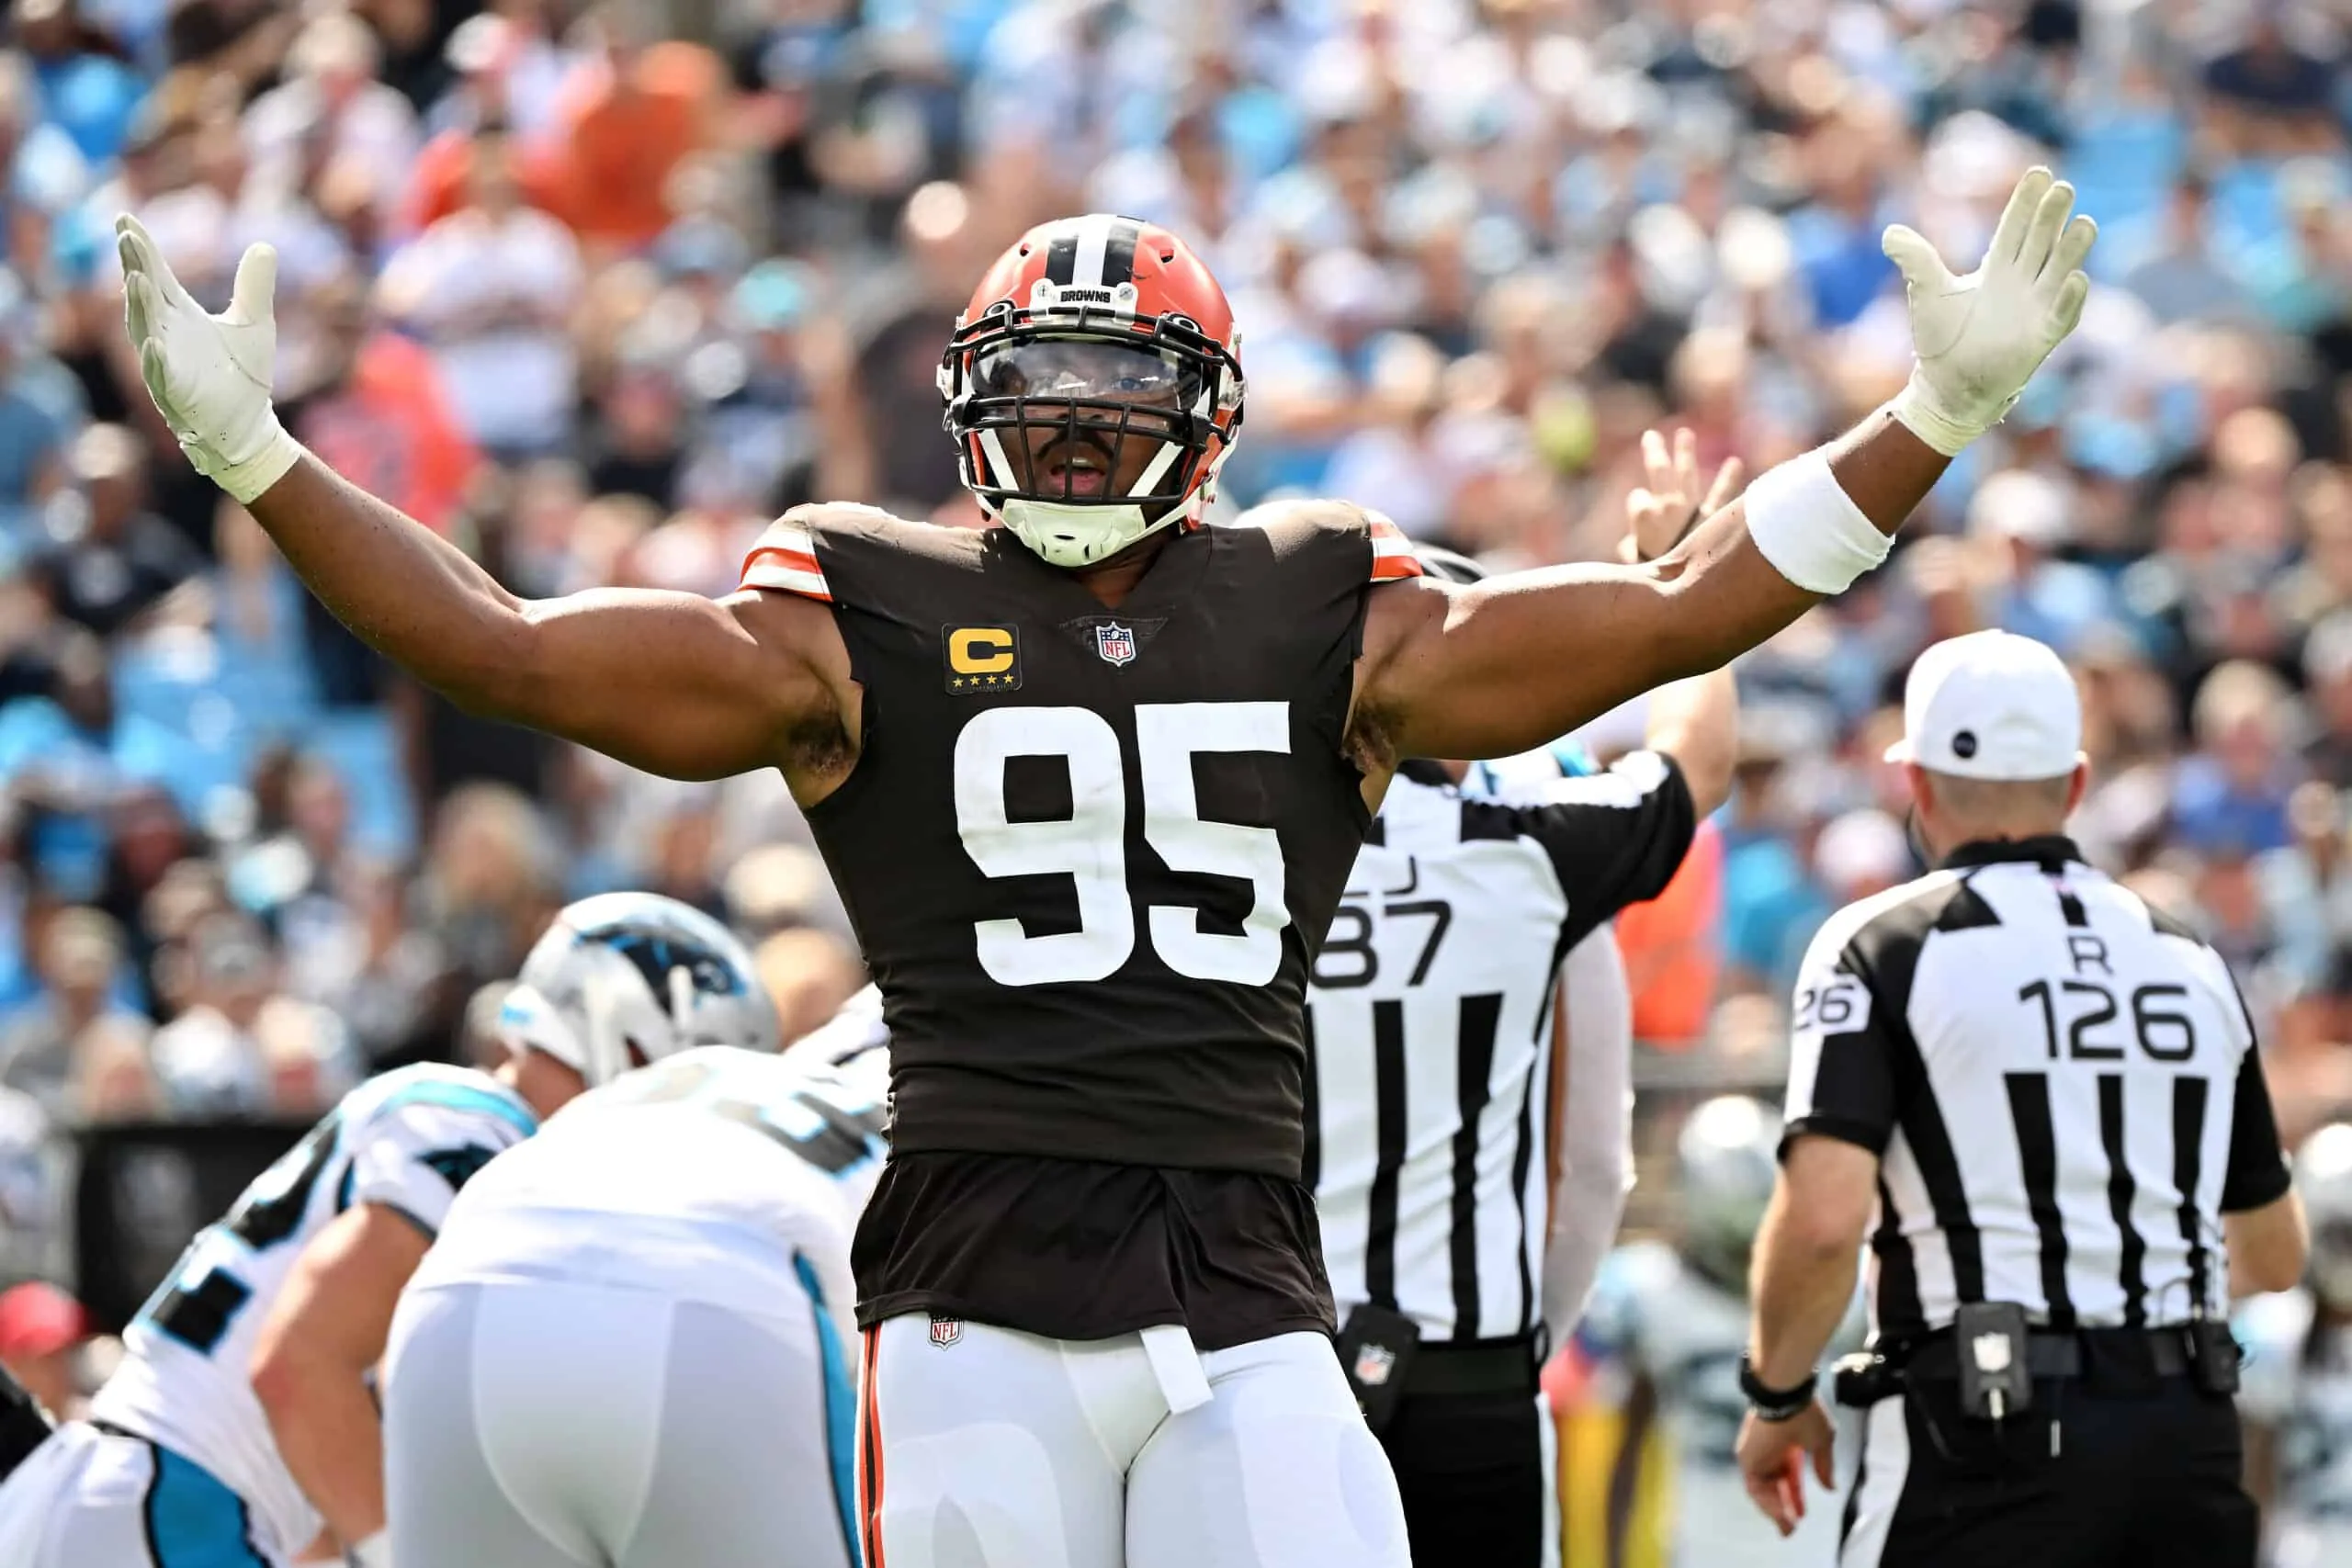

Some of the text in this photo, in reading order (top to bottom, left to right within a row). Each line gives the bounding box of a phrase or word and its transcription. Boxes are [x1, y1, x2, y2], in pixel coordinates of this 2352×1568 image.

[1060, 289, 1111, 303] BROWNS
[949, 628, 1013, 673] C
[1104, 641, 1130, 658] NFL
[954, 701, 1292, 987] 95
[1308, 900, 1453, 989] 87
[2066, 935, 2116, 976] R
[2018, 978, 2196, 1062] 126
[933, 1322, 957, 1340] NFL
